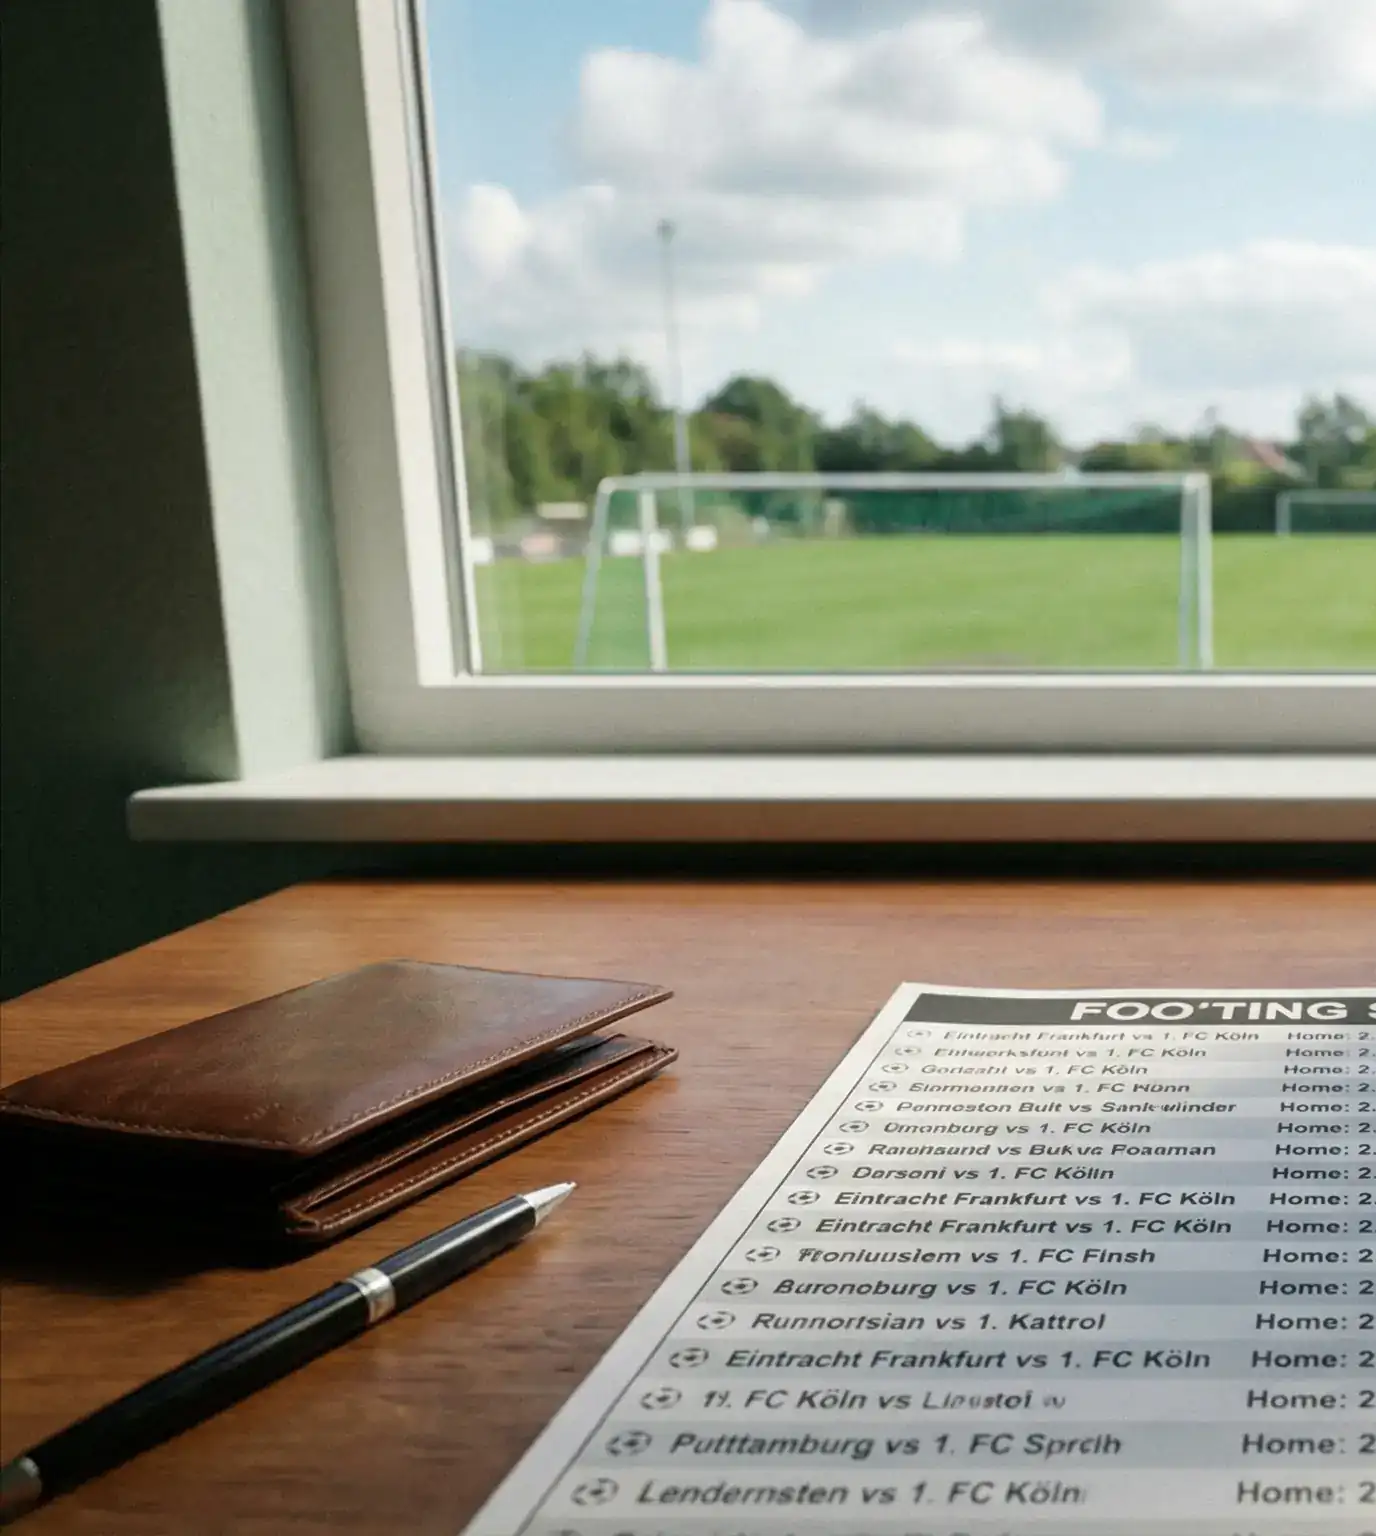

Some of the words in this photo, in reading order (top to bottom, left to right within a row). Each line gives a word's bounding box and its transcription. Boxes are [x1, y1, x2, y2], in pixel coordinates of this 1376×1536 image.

[1096, 1083, 1125, 1093] FC
[1282, 1083, 1350, 1093] Home:
[1069, 1104, 1092, 1113] vs
[1280, 1101, 1349, 1113] Home:
[1006, 1125, 1029, 1134] vs
[1040, 1123, 1055, 1134] 1.
[1063, 1123, 1094, 1134] FC
[1100, 1121, 1151, 1134] Köln
[1277, 1122, 1349, 1134] Home:
[997, 1146, 1022, 1156] vs
[1275, 1144, 1349, 1156] Home:
[953, 1170, 979, 1180] vs
[989, 1167, 1006, 1180] 1.
[1014, 1167, 1048, 1180] FC
[1272, 1166, 1349, 1180] Home:
[834, 1191, 948, 1206] Eintracht
[953, 1192, 1068, 1206] Frankfurt
[1075, 1196, 1101, 1206] vs
[1112, 1193, 1129, 1205] 1.
[1139, 1192, 1172, 1205] FC
[1180, 1191, 1235, 1205] Köln
[1269, 1192, 1348, 1205] Home:
[815, 1218, 933, 1233] Eintracht
[939, 1219, 1058, 1234] Frankfurt
[1065, 1222, 1092, 1234] vs
[1103, 1220, 1121, 1233] 1.
[1131, 1219, 1166, 1233] FC
[1174, 1218, 1231, 1234] Köln
[1267, 1219, 1348, 1234] Home:
[971, 1252, 999, 1263] vs
[1010, 1249, 1027, 1263] 1.
[1038, 1248, 1075, 1263] FC
[1263, 1248, 1348, 1263] Home:
[947, 1284, 977, 1295] vs
[988, 1280, 1007, 1296] 1.
[1018, 1280, 1056, 1296] FC
[1064, 1279, 1127, 1296] Köln
[1259, 1280, 1348, 1296] Home:
[936, 1317, 966, 1330] vs
[980, 1313, 997, 1330] 1.
[1256, 1313, 1347, 1330] Home:
[725, 1349, 863, 1368] Eintracht
[870, 1350, 1007, 1368] Frankfurt
[1016, 1354, 1047, 1368] vs
[1061, 1351, 1080, 1368] 1.
[1092, 1350, 1133, 1368] FC
[1143, 1349, 1210, 1369] Köln
[1251, 1350, 1347, 1368] Home:
[744, 1389, 789, 1409] FC
[796, 1389, 868, 1409] Köln
[878, 1395, 912, 1410] vs
[1246, 1389, 1346, 1409] Home:
[886, 1438, 920, 1455] vs
[935, 1433, 956, 1454] 1.
[969, 1433, 1015, 1455] FC
[1242, 1433, 1345, 1454] Home:
[862, 1487, 897, 1505] vs
[913, 1481, 933, 1504] 1.
[947, 1480, 995, 1505] FC
[1237, 1480, 1344, 1504] Home:
